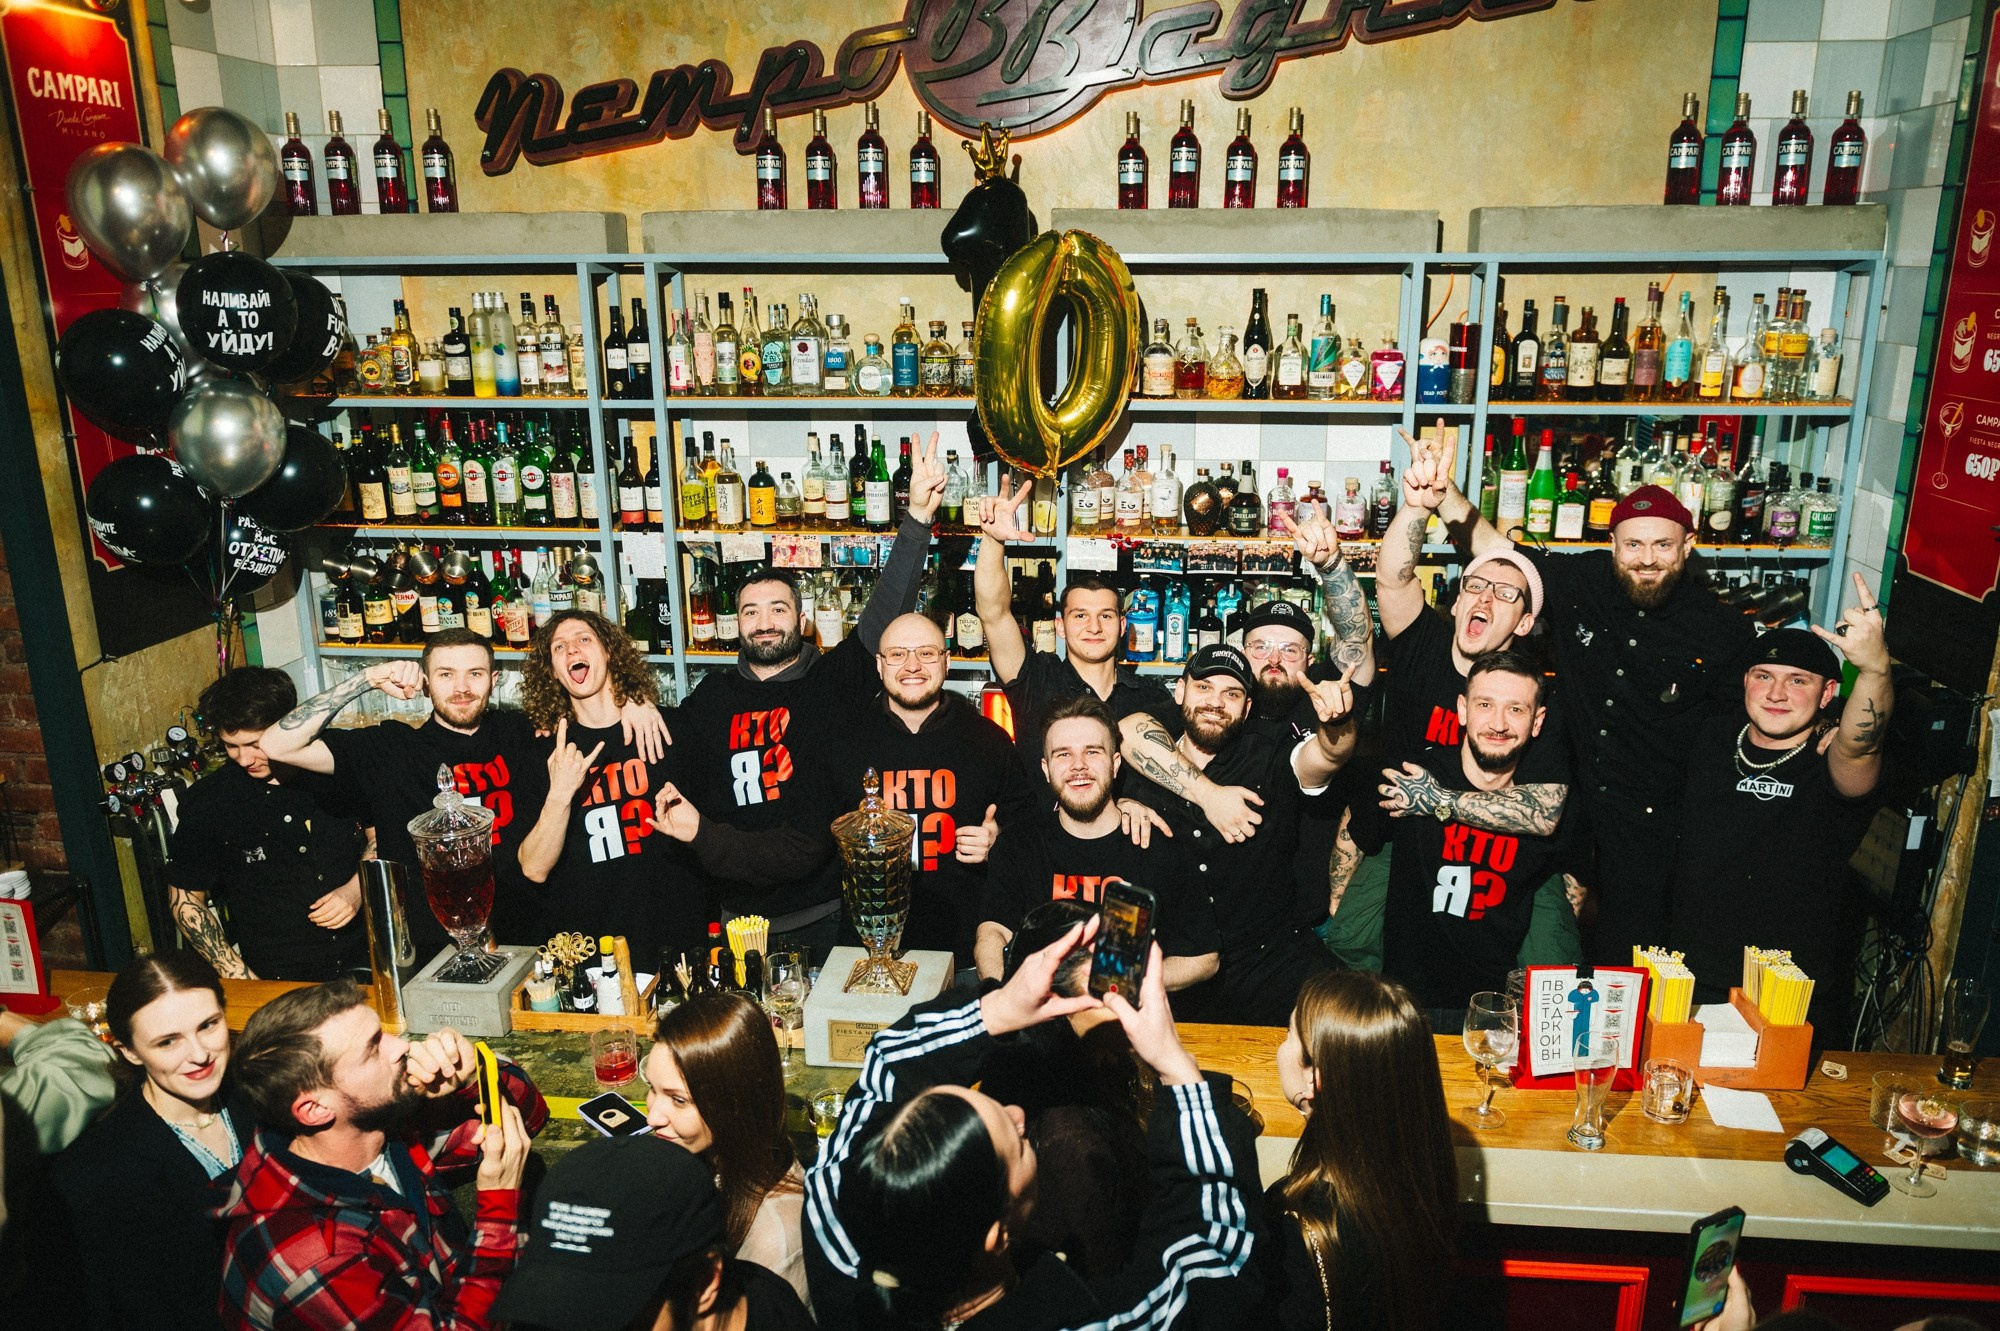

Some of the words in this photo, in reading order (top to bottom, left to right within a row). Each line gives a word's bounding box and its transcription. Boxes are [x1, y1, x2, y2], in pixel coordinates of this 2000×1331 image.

[27, 66, 123, 109] CAMPARI
[61, 127, 106, 139] MILANO
[202, 289, 271, 310] НАЛИВАЙ!
[217, 309, 229, 328] А
[237, 310, 259, 330] ТО
[206, 330, 274, 356] УЙДУ!
[1983, 347, 2000, 374] 65
[1976, 413, 2000, 430] CAMPA
[1969, 436, 1987, 447] FIESTA
[1987, 439, 2000, 449] NEGR
[690, 496, 706, 507] LESS
[720, 626, 732, 635] 12
[1211, 650, 1232, 659] TOMMY
[729, 706, 791, 750] КТО
[730, 744, 794, 807] Я?
[883, 768, 957, 811] КТО
[1738, 780, 1793, 796] MARTINI
[584, 799, 655, 864] Я?
[1441, 822, 1519, 873] КТО
[1432, 865, 1507, 921] Я?
